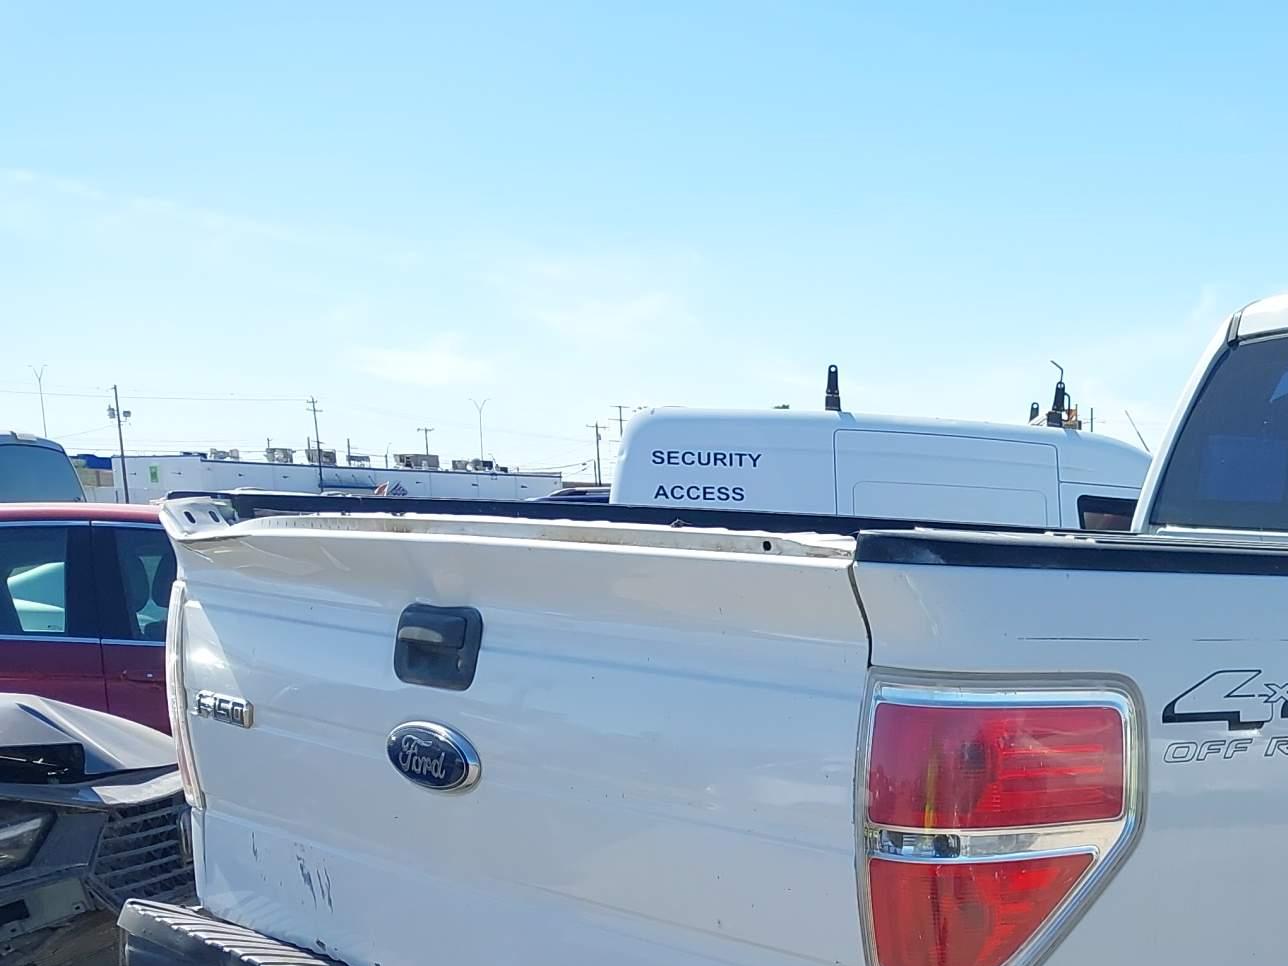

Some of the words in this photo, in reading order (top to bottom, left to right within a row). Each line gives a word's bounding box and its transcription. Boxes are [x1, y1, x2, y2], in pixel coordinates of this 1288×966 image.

[651, 450, 762, 468] SECURITY
[654, 485, 745, 502] ACCESS
[399, 734, 446, 779] Ford
[1163, 738, 1253, 763] OFF
